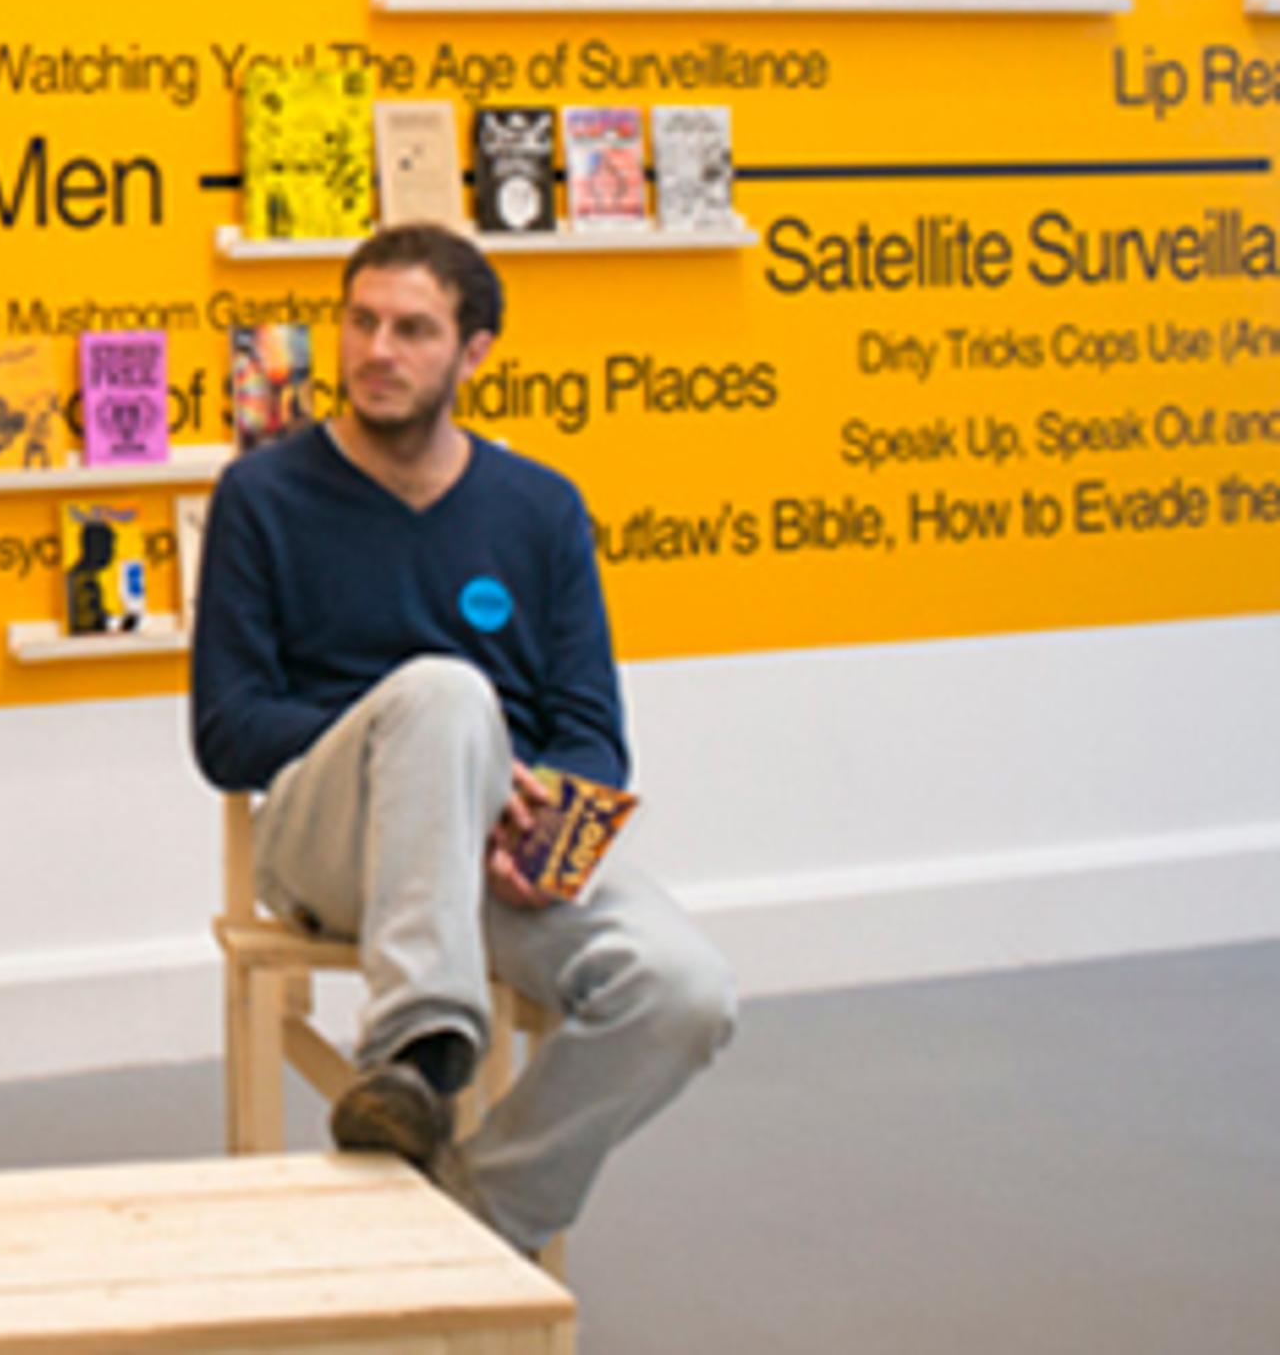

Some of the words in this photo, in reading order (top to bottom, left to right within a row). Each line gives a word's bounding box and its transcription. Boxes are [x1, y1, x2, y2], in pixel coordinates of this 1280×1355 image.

[426, 41, 518, 103] Age
[527, 43, 570, 91] of
[578, 38, 830, 92] Surveillance
[1112, 45, 1189, 121] Lip
[764, 214, 1015, 296] Satellite
[1026, 210, 1280, 285] Surveilla
[6, 295, 202, 337] Mushroom
[604, 353, 779, 414] Places
[858, 327, 938, 383] Dirty
[945, 328, 1046, 370] Tricks
[1049, 321, 1140, 375] Cops
[1147, 319, 1212, 365] Use
[840, 415, 958, 473] Speak
[966, 417, 1028, 467] Up,
[1034, 407, 1146, 465] Speak
[1153, 403, 1216, 451] Out
[772, 495, 898, 553] Bible,
[908, 490, 1014, 545] How
[1020, 485, 1064, 539] to
[1072, 477, 1210, 537] Evade
[1218, 470, 1280, 525] the
